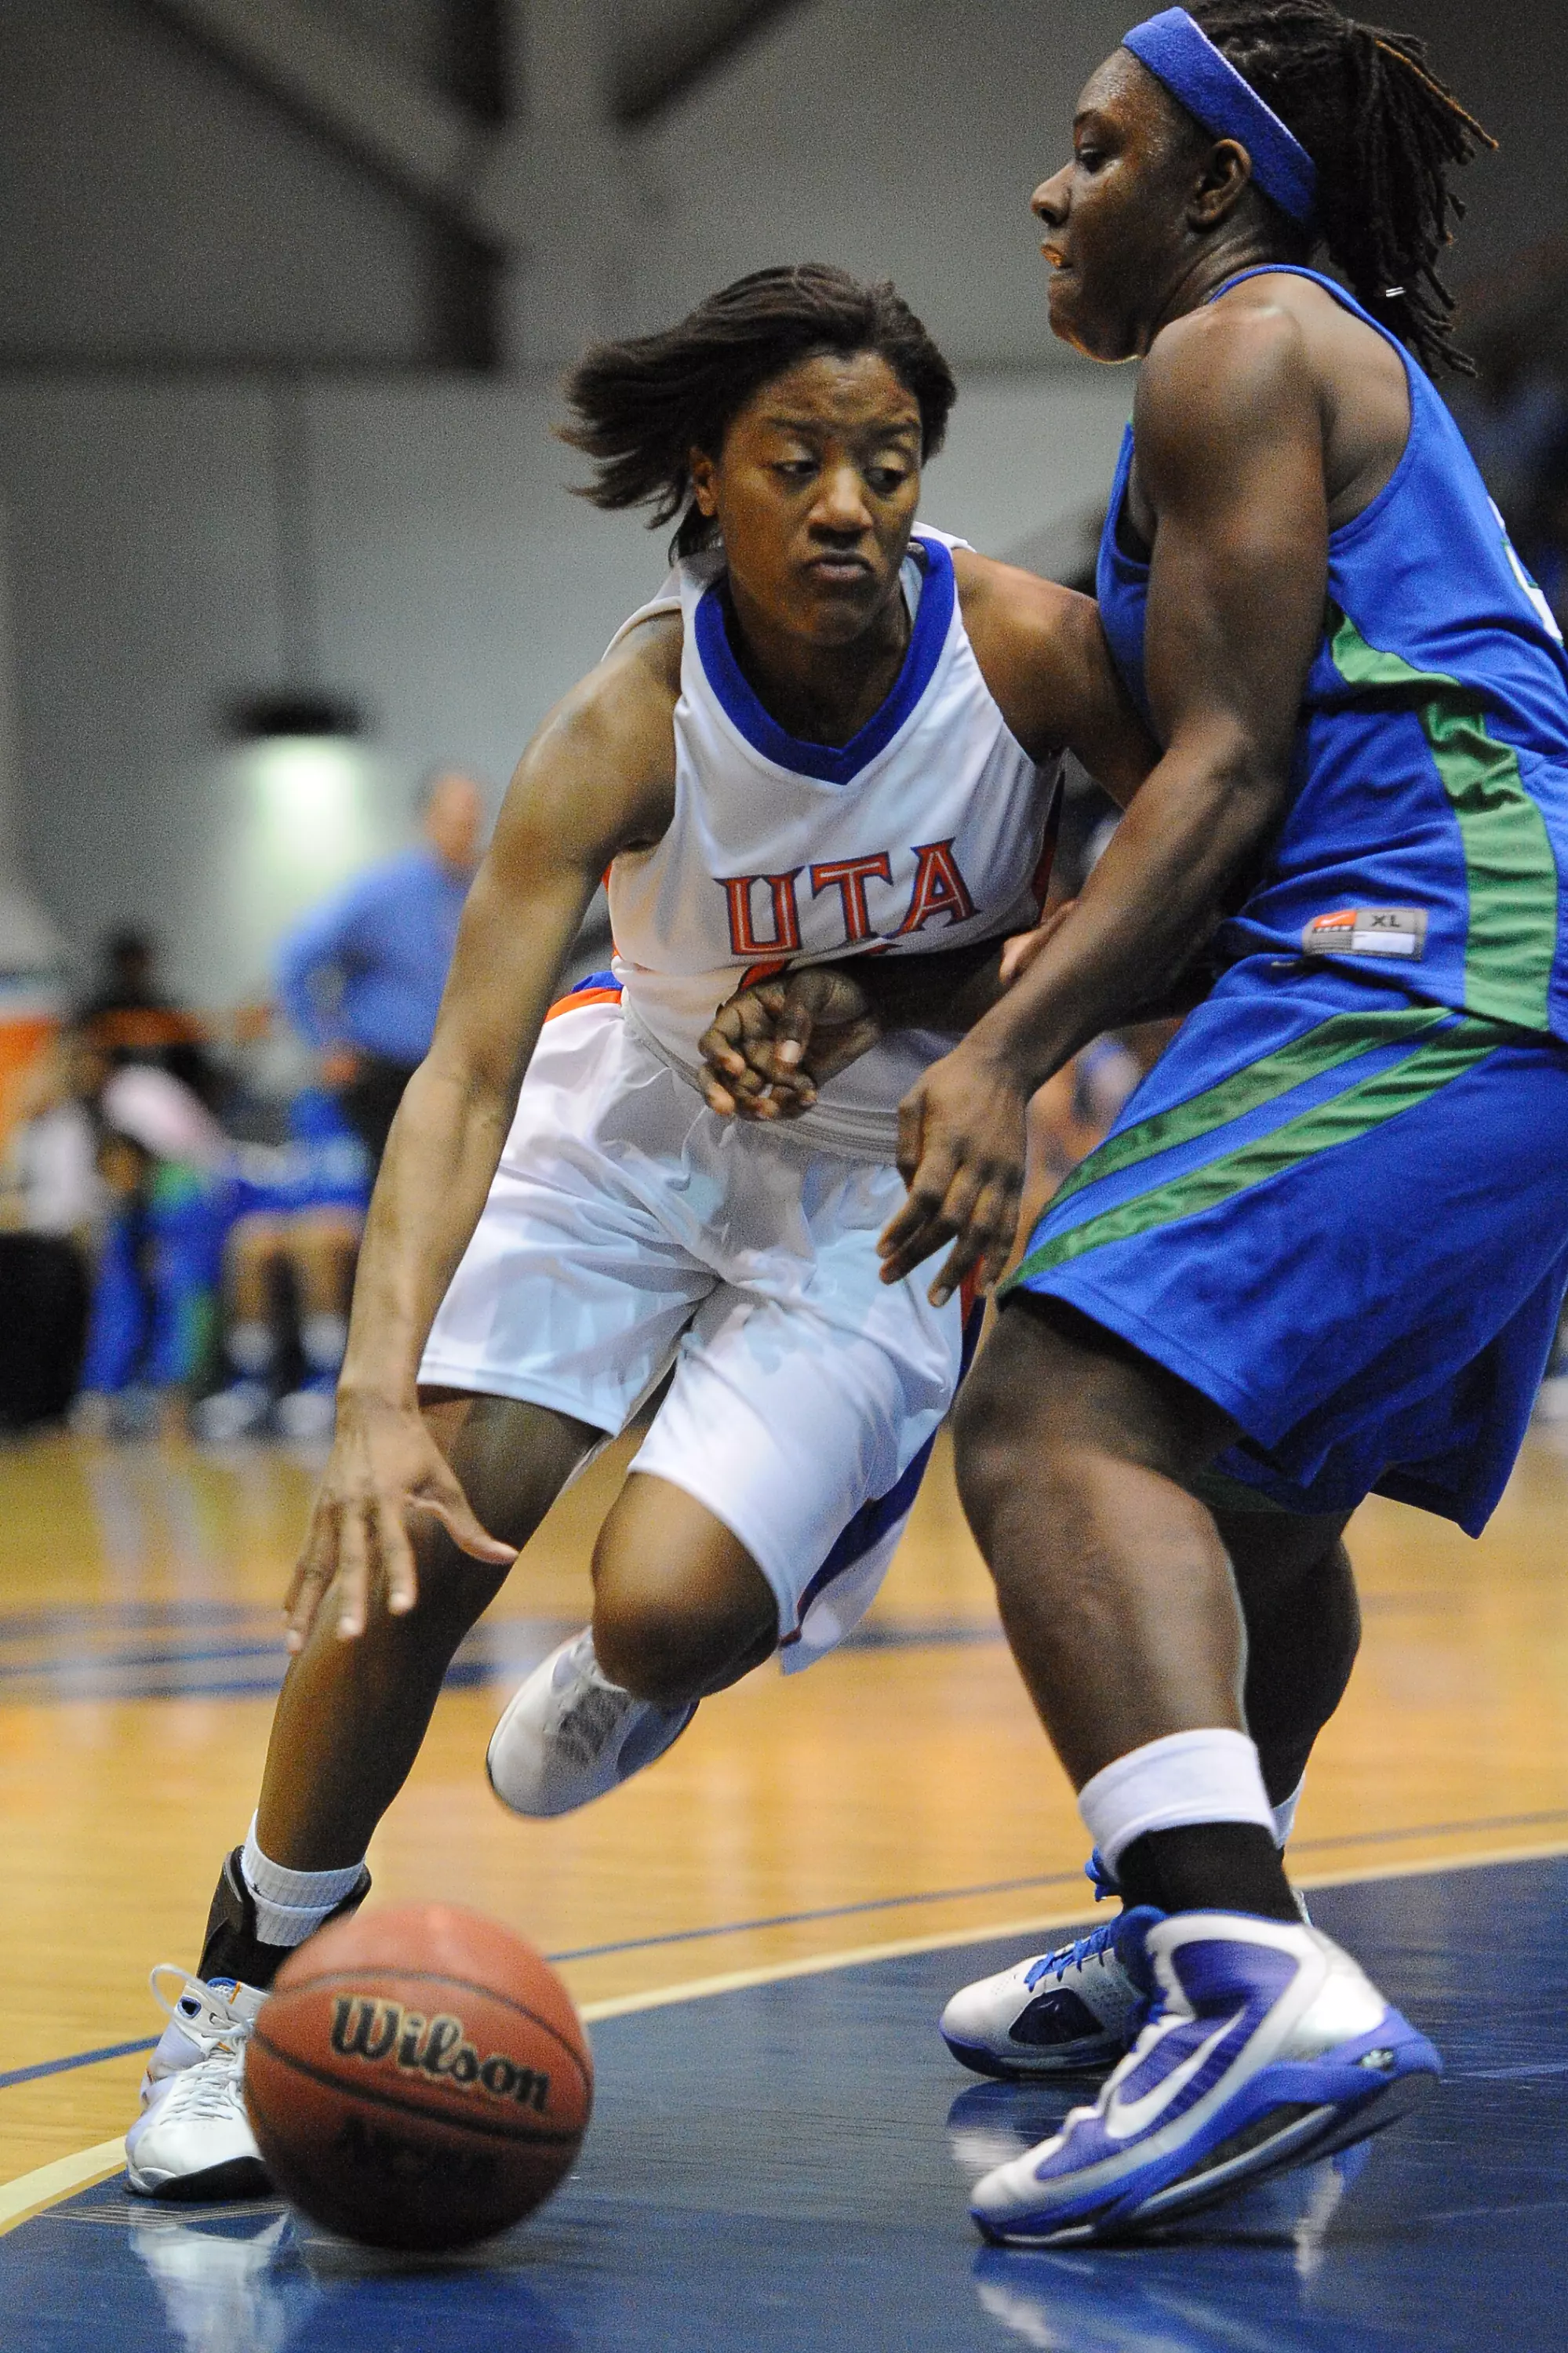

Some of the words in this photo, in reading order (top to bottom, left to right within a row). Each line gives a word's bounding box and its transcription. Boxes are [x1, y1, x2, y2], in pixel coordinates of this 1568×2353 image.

[712, 837, 980, 955] UTA
[1370, 915, 1401, 928] XL
[330, 1996, 549, 2111] Wilson
